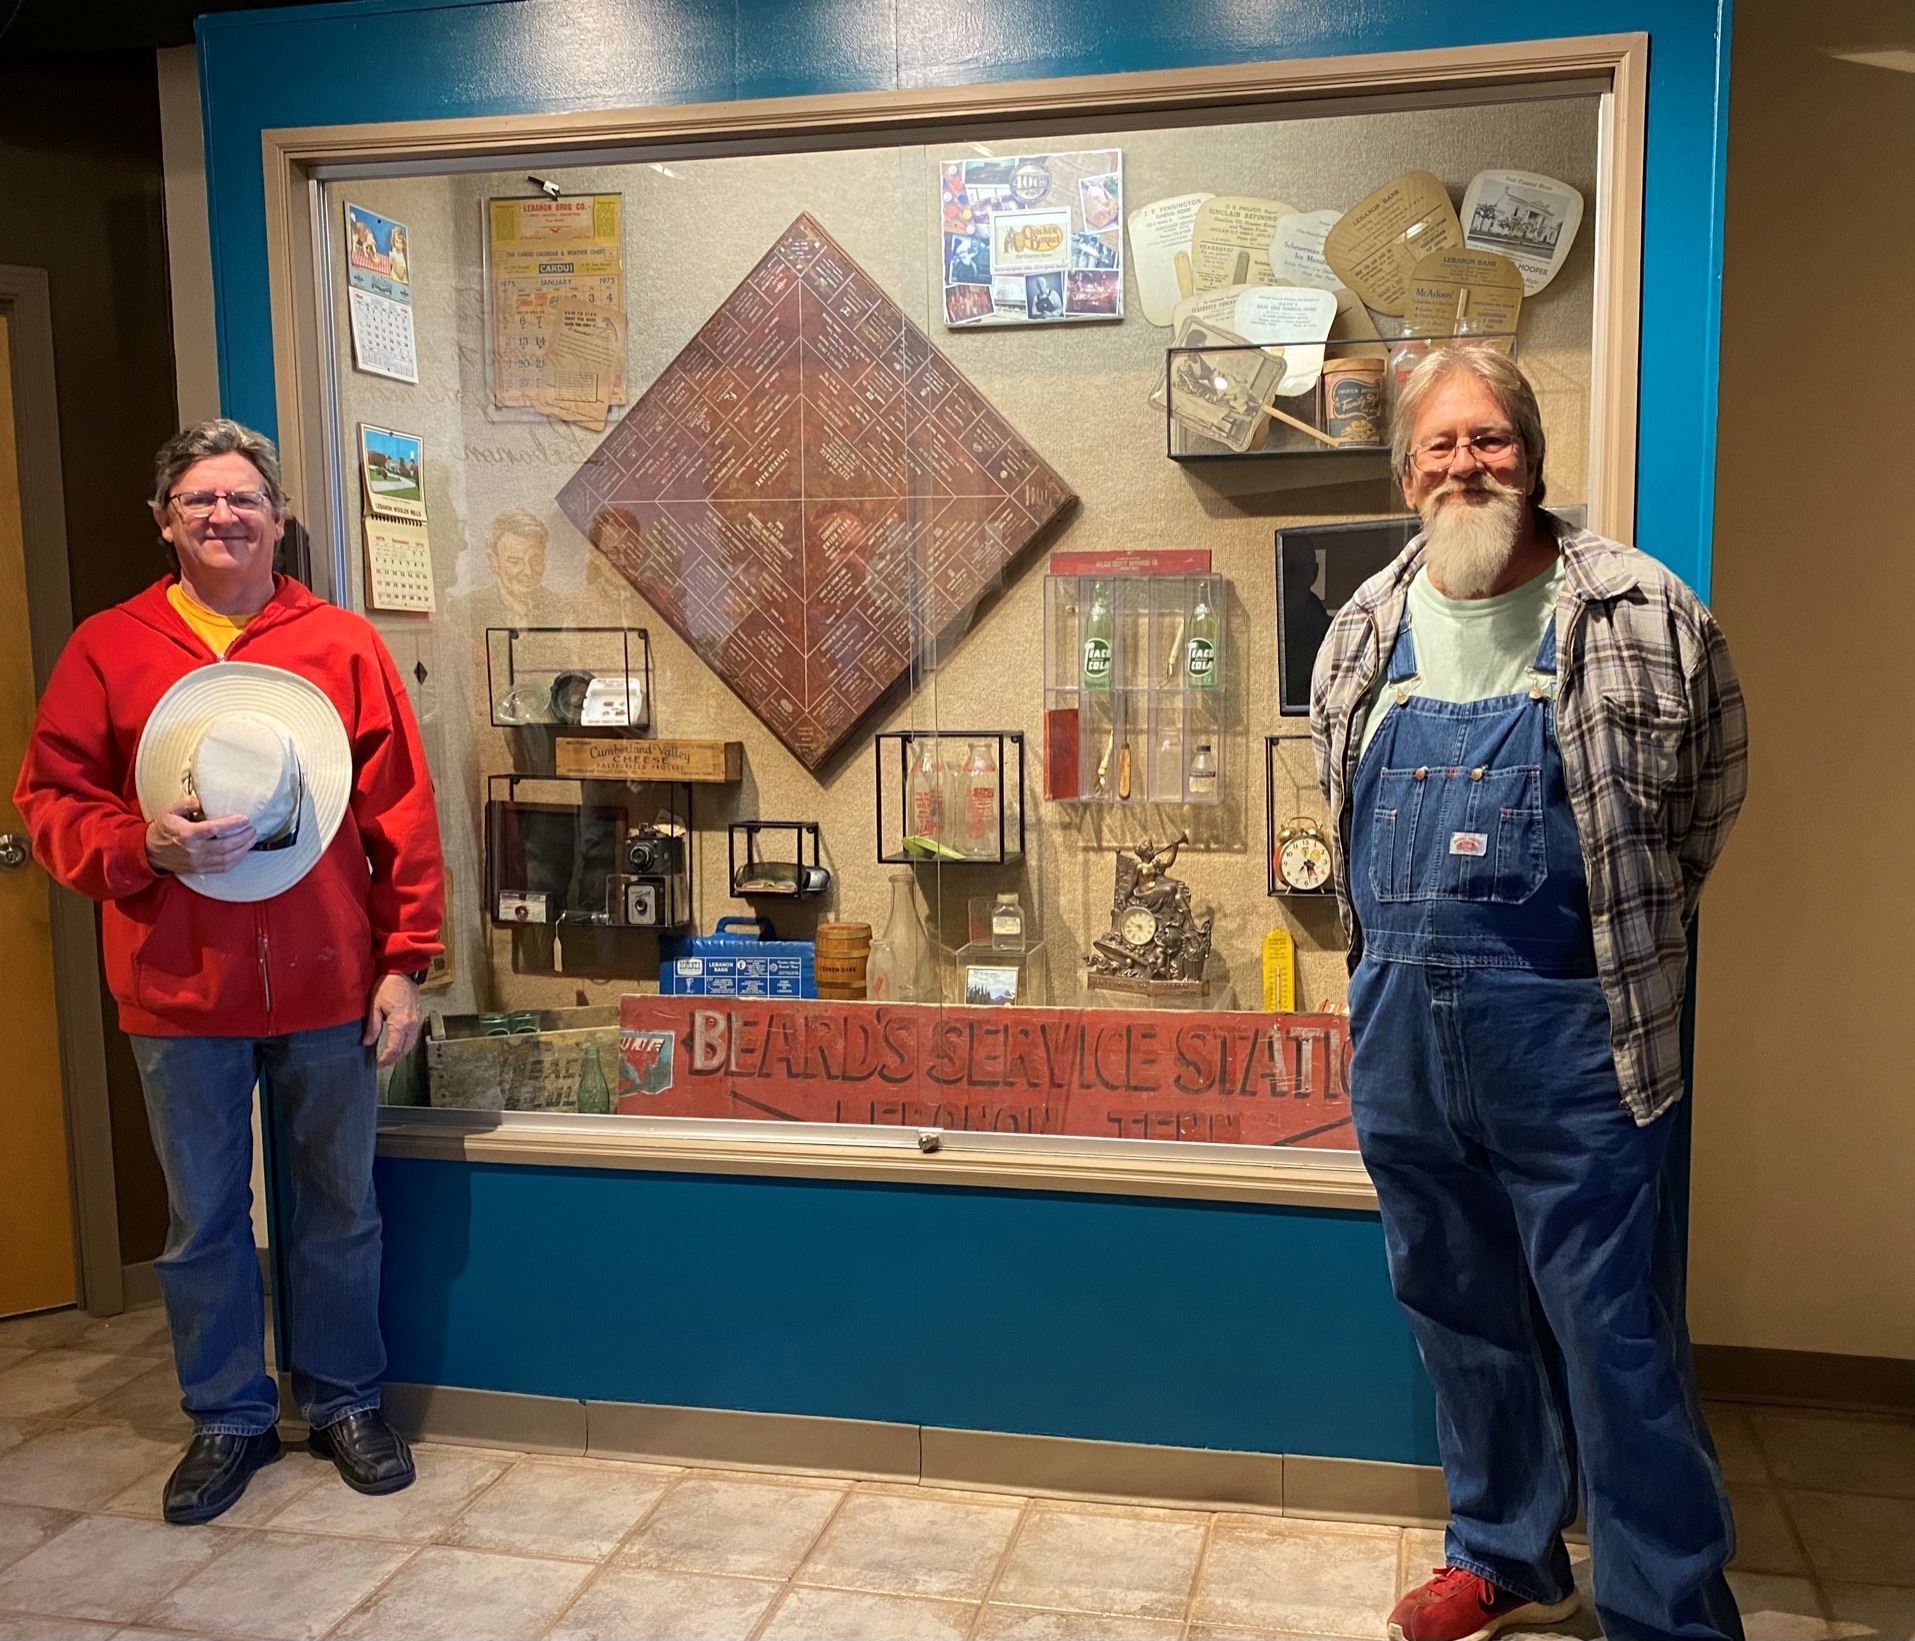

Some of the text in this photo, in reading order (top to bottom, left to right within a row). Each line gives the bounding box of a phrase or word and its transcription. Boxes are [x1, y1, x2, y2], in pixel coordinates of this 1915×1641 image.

[523, 202, 588, 213] LEBANON DRUG CO.
[1353, 189, 1400, 225] LEBANON BANK
[1209, 208, 1278, 222] SINCLAIR REFINING
[1443, 256, 1497, 267] LEBANON BANK
[540, 264, 574, 273] CARDUI
[1519, 263, 1548, 276] HOOPER
[541, 279, 573, 287] JANUARY
[599, 277, 616, 285] 1975
[588, 294, 613, 303] 3 4
[766, 447, 790, 473] LEBANON
[817, 446, 839, 469] GARAGE
[1088, 661, 1110, 671] COLA
[1191, 661, 1213, 670] COLA
[590, 743, 690, 765] Cumberland Valley
[612, 755, 667, 765] CHEESE
[687, 1008, 914, 1084] BEARD'S
[926, 1018, 1161, 1093] SERVICE
